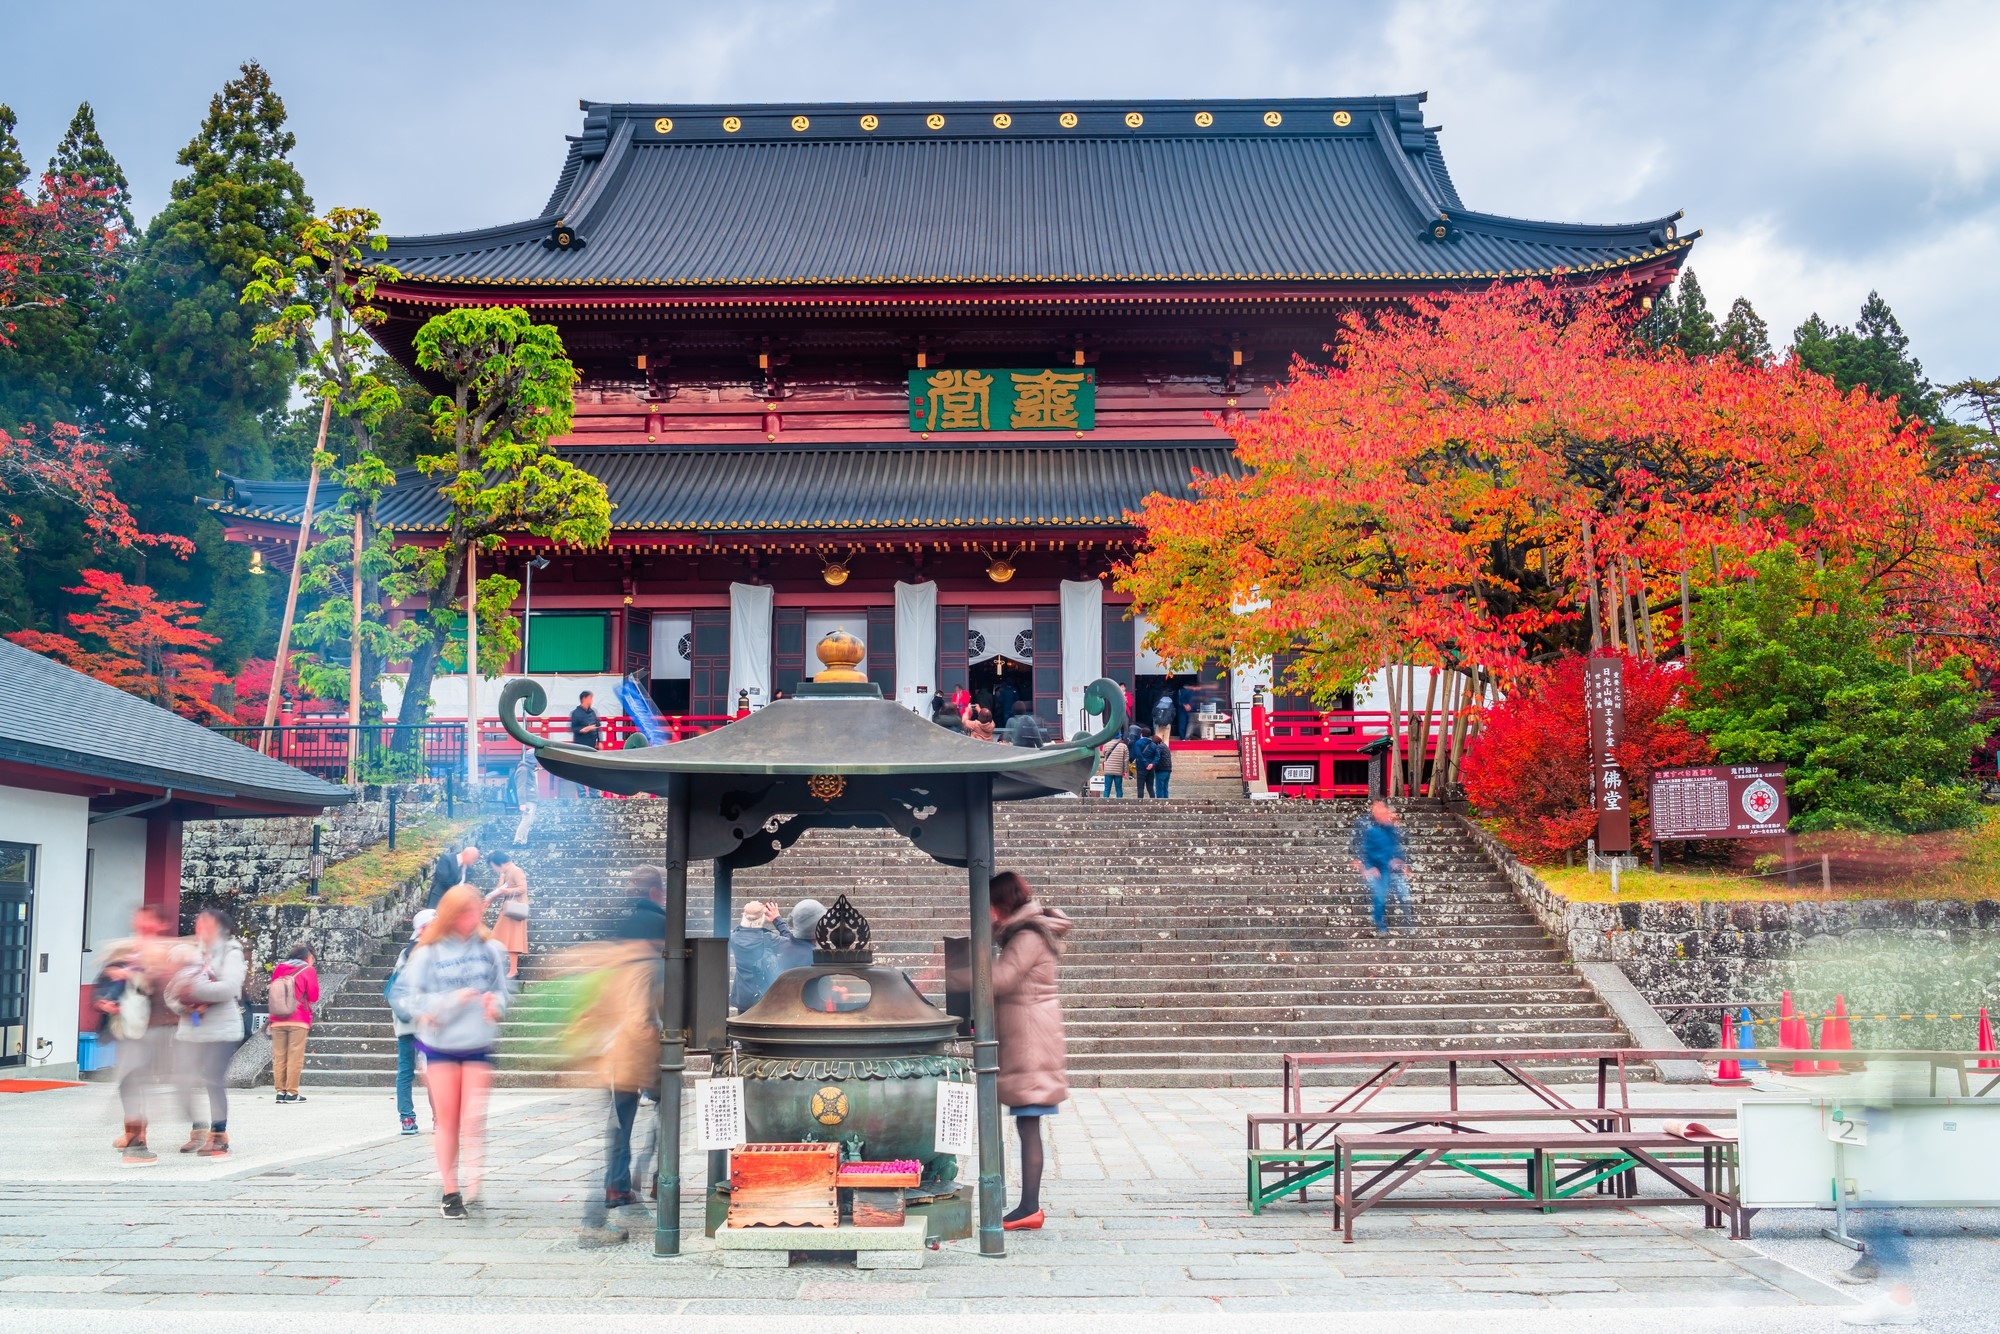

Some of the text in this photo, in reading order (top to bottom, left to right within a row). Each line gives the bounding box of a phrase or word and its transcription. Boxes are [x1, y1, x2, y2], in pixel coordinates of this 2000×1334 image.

[1594, 673, 1603, 709] 世界遺産
[1613, 671, 1621, 709] 重要文化財
[1601, 667, 1623, 811] 日光山輪王寺本堂 三佛堂
[1839, 1120, 1858, 1141] 2
